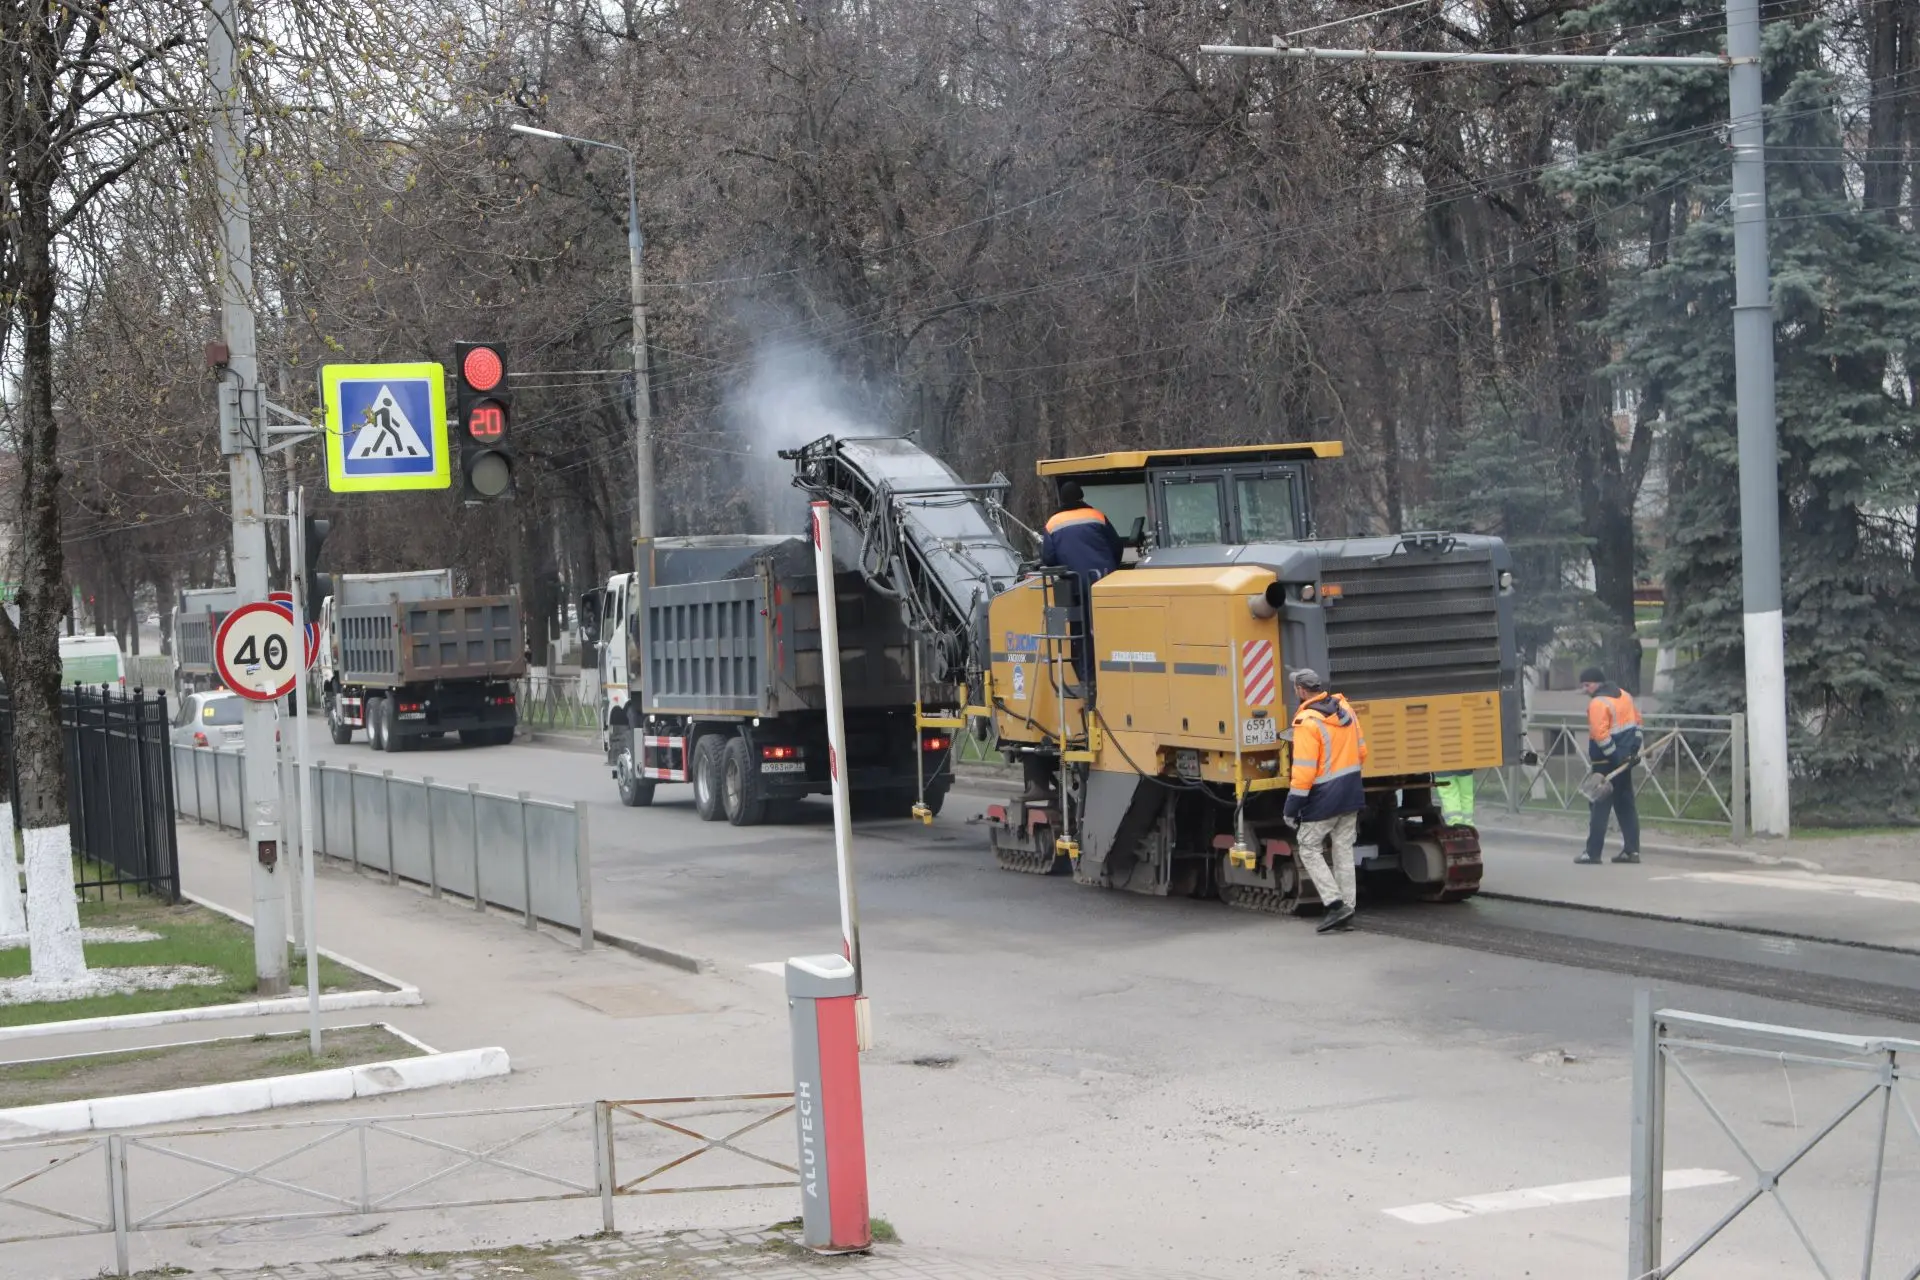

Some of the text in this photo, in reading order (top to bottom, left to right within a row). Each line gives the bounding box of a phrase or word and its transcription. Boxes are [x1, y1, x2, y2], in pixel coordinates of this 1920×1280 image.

[472, 408, 501, 435] 20
[233, 633, 288, 671] 40
[1246, 719, 1273, 731] 6591
[1264, 731, 1274, 740] 32
[799, 1081, 818, 1198] ALUTECH
